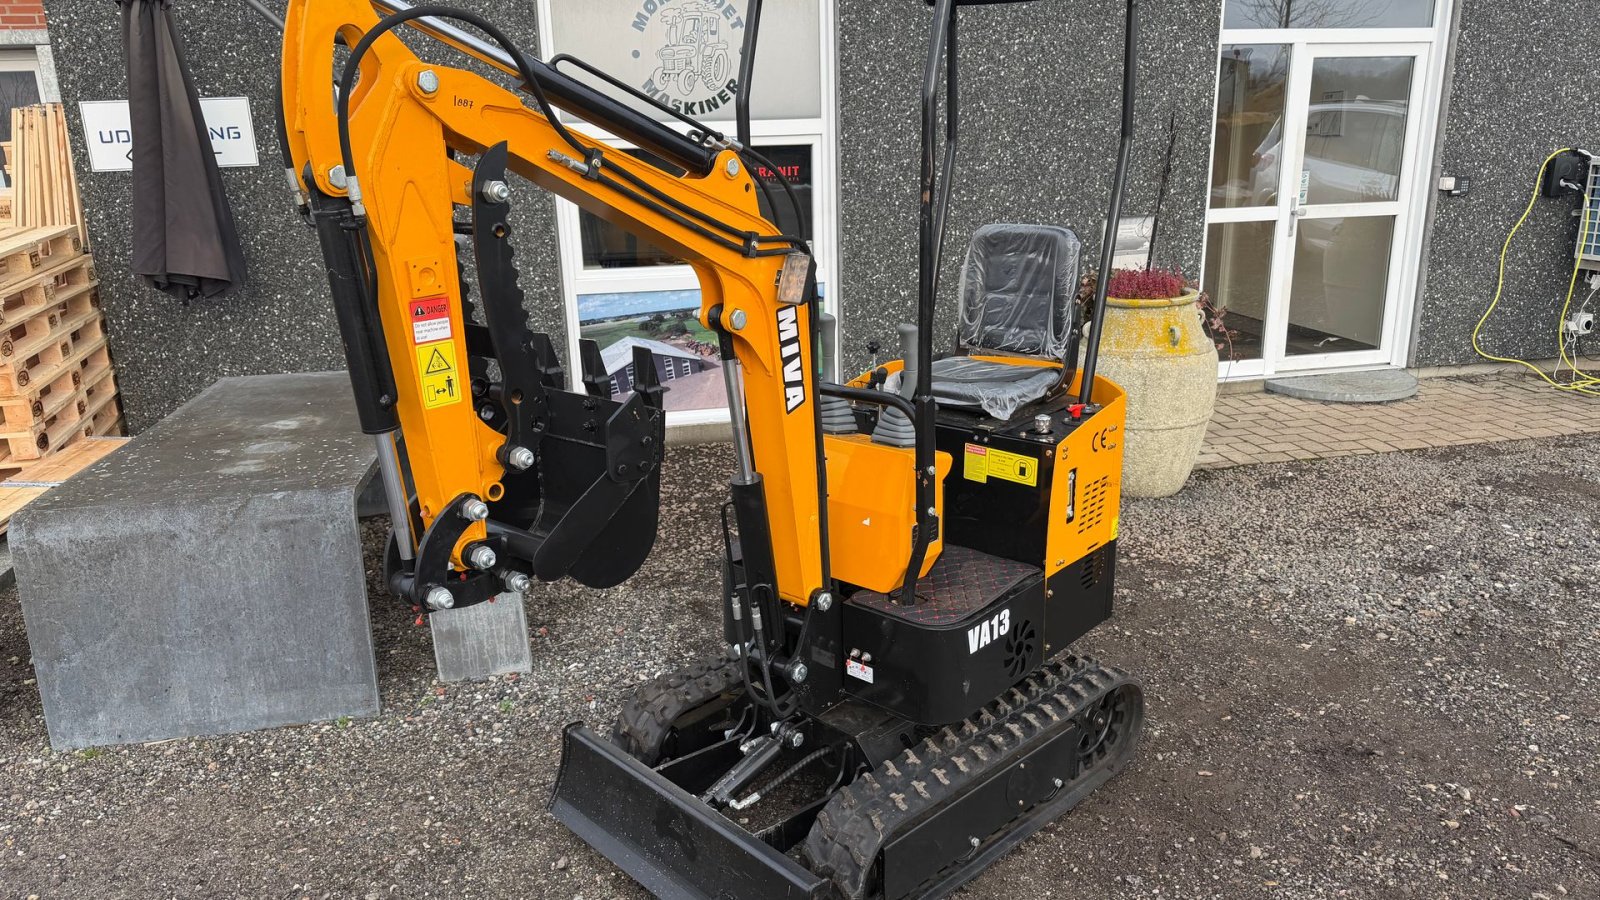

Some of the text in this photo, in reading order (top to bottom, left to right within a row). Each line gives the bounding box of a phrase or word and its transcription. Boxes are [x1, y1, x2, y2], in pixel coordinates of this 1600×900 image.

[454, 95, 474, 109] 1887
[641, 78, 739, 115] MASKINER
[754, 166, 800, 177] RANIT
[426, 304, 448, 315] DANGER
[776, 305, 806, 414] MIVA
[1091, 427, 1108, 453] CE
[966, 608, 1011, 655] VA13
